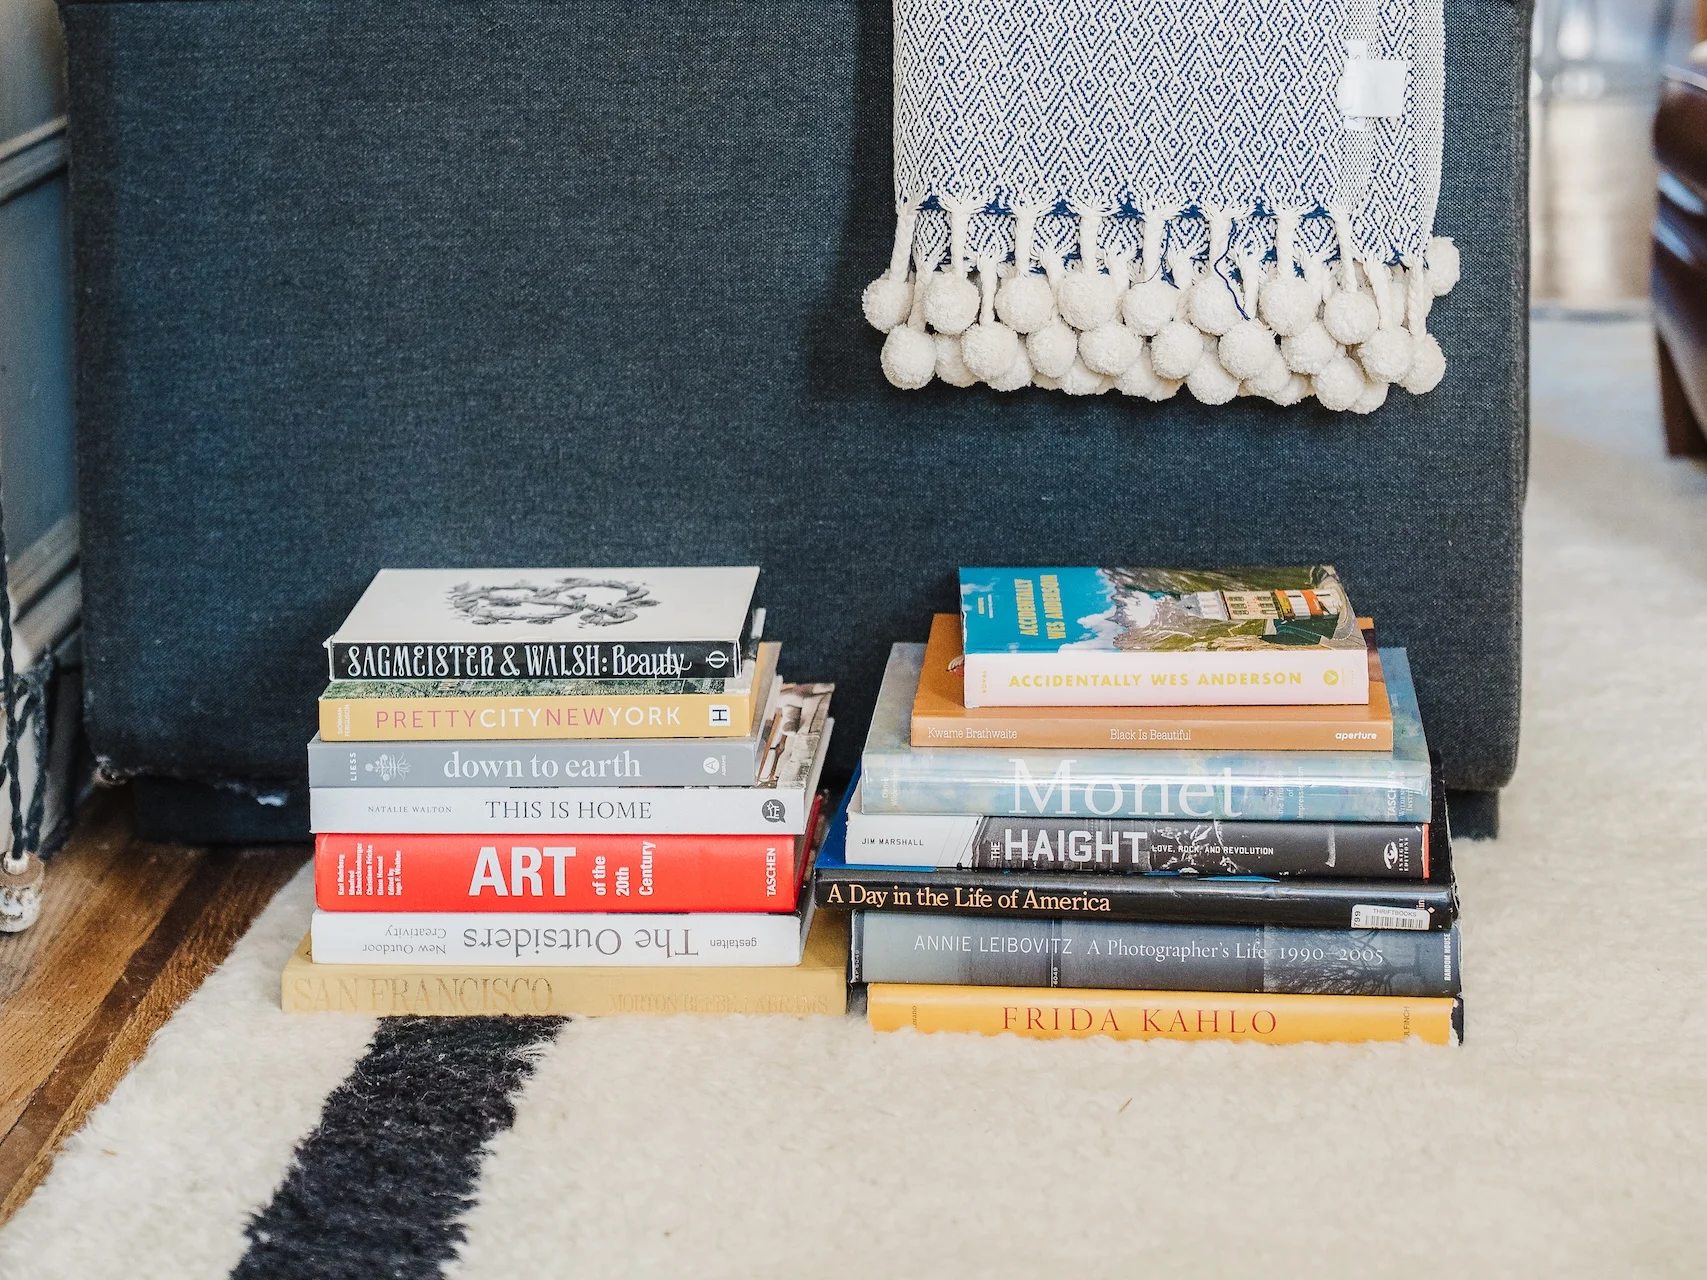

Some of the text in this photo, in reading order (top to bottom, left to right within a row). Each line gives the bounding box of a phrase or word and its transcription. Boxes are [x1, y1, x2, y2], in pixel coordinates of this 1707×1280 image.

[1014, 578, 1039, 636] ACCIDENTALLY
[1040, 574, 1066, 639] WES ANDERSON
[348, 644, 692, 679] SAGMEISTER & WALSH: Beauty
[1008, 672, 1302, 688] ACCIDENTALLY WES ANDERSON
[928, 727, 1017, 739] Kwame Brathwaite
[1110, 728, 1191, 740] Black Is Beautiful
[1335, 731, 1377, 741] aperture
[443, 750, 642, 778] down to earth
[1008, 758, 1243, 818] Monet
[485, 801, 652, 819] THIS IS HOME
[862, 837, 924, 846] JIM MARSHALL
[991, 841, 1000, 860] THE
[1004, 828, 1148, 864] HAIGHT
[1204, 845, 1221, 854] AND
[1223, 846, 1274, 855] REVOLUTION
[468, 846, 577, 897] ART
[591, 855, 607, 896] of the
[615, 867, 630, 897] 20th
[638, 841, 656, 896] Century
[766, 847, 777, 897] TASCHEN
[827, 883, 1111, 912] A Day in the Life of America
[1373, 908, 1416, 917] THRIFTBOOKS
[385, 925, 447, 939] Creativity
[463, 928, 698, 958] The Outsiders
[710, 937, 757, 947] gestalten
[362, 944, 447, 954] New Outdoor
[914, 935, 971, 952] ANNIE
[980, 937, 1073, 954] LEIBOVITZ
[1087, 939, 1100, 955] A
[1235, 942, 1267, 959] Life
[293, 977, 553, 1012] SAN FRANCISCO
[1002, 1007, 1277, 1034] FRIDA KAHLO
